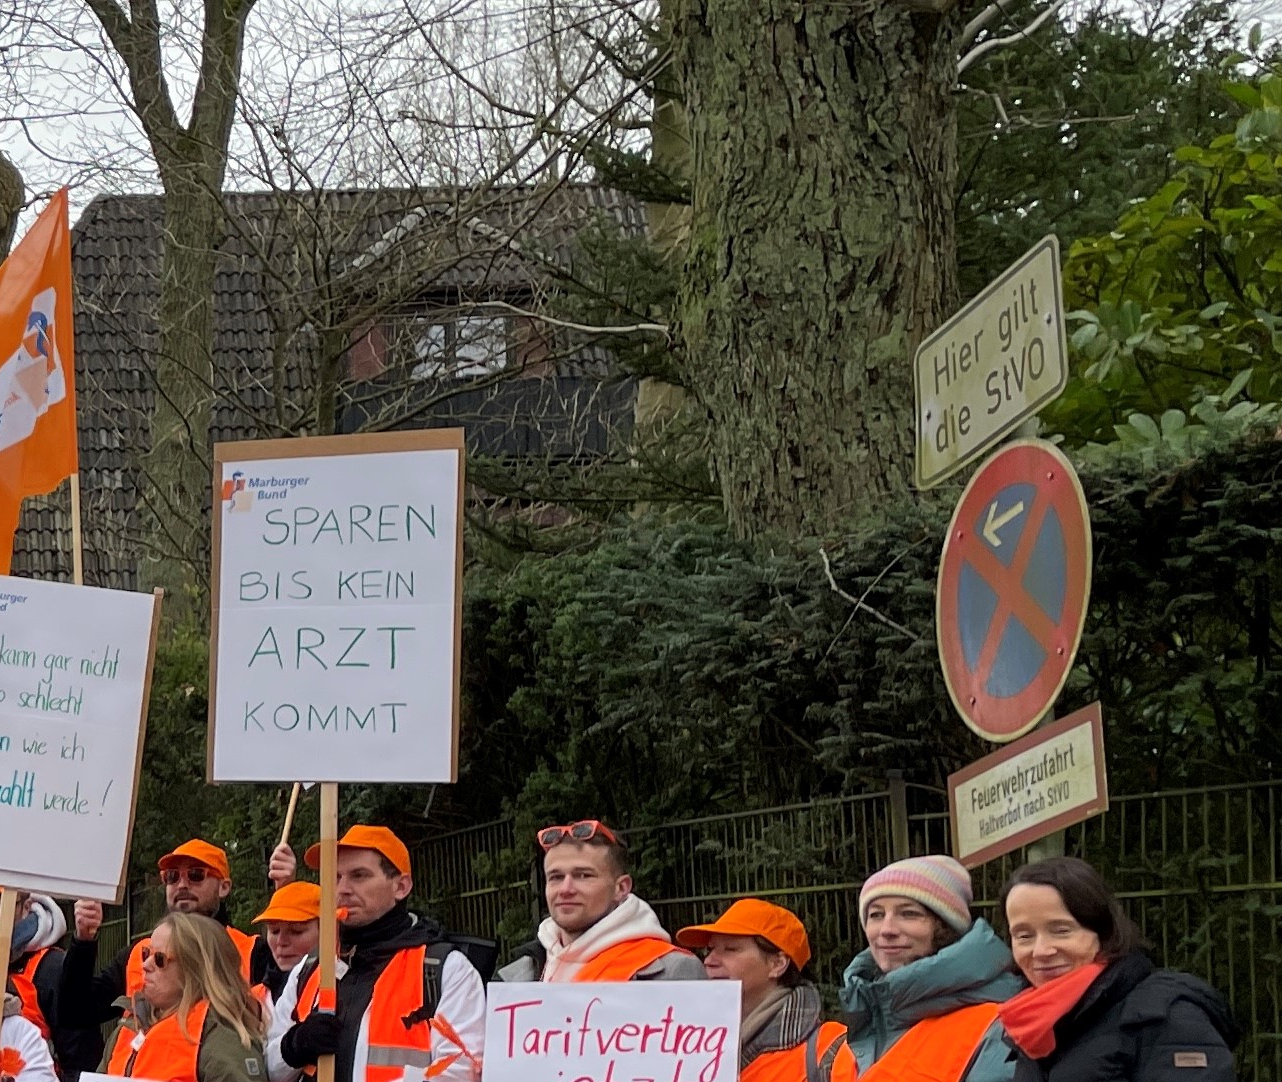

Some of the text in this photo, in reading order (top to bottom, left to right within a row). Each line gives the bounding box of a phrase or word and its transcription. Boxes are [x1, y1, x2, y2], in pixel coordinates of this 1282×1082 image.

[933, 278, 1039, 396] Hier gilt
[935, 337, 1045, 453] die StVO
[248, 475, 310, 489] Marburger
[257, 489, 288, 500] Bund
[262, 505, 436, 545] SPAREN
[239, 571, 414, 601] BIS KEIN
[43, 653, 73, 683] gar
[80, 644, 120, 680] nicht
[248, 626, 416, 670] ARZT
[19, 681, 84, 717] schlecht
[244, 701, 407, 733] KOMMT
[23, 733, 48, 755] wie
[60, 732, 86, 762] ich
[971, 743, 1076, 814] Feuerwehrzufahrt
[43, 781, 90, 816] werde
[979, 780, 1070, 839] Haltverbot nach StVO
